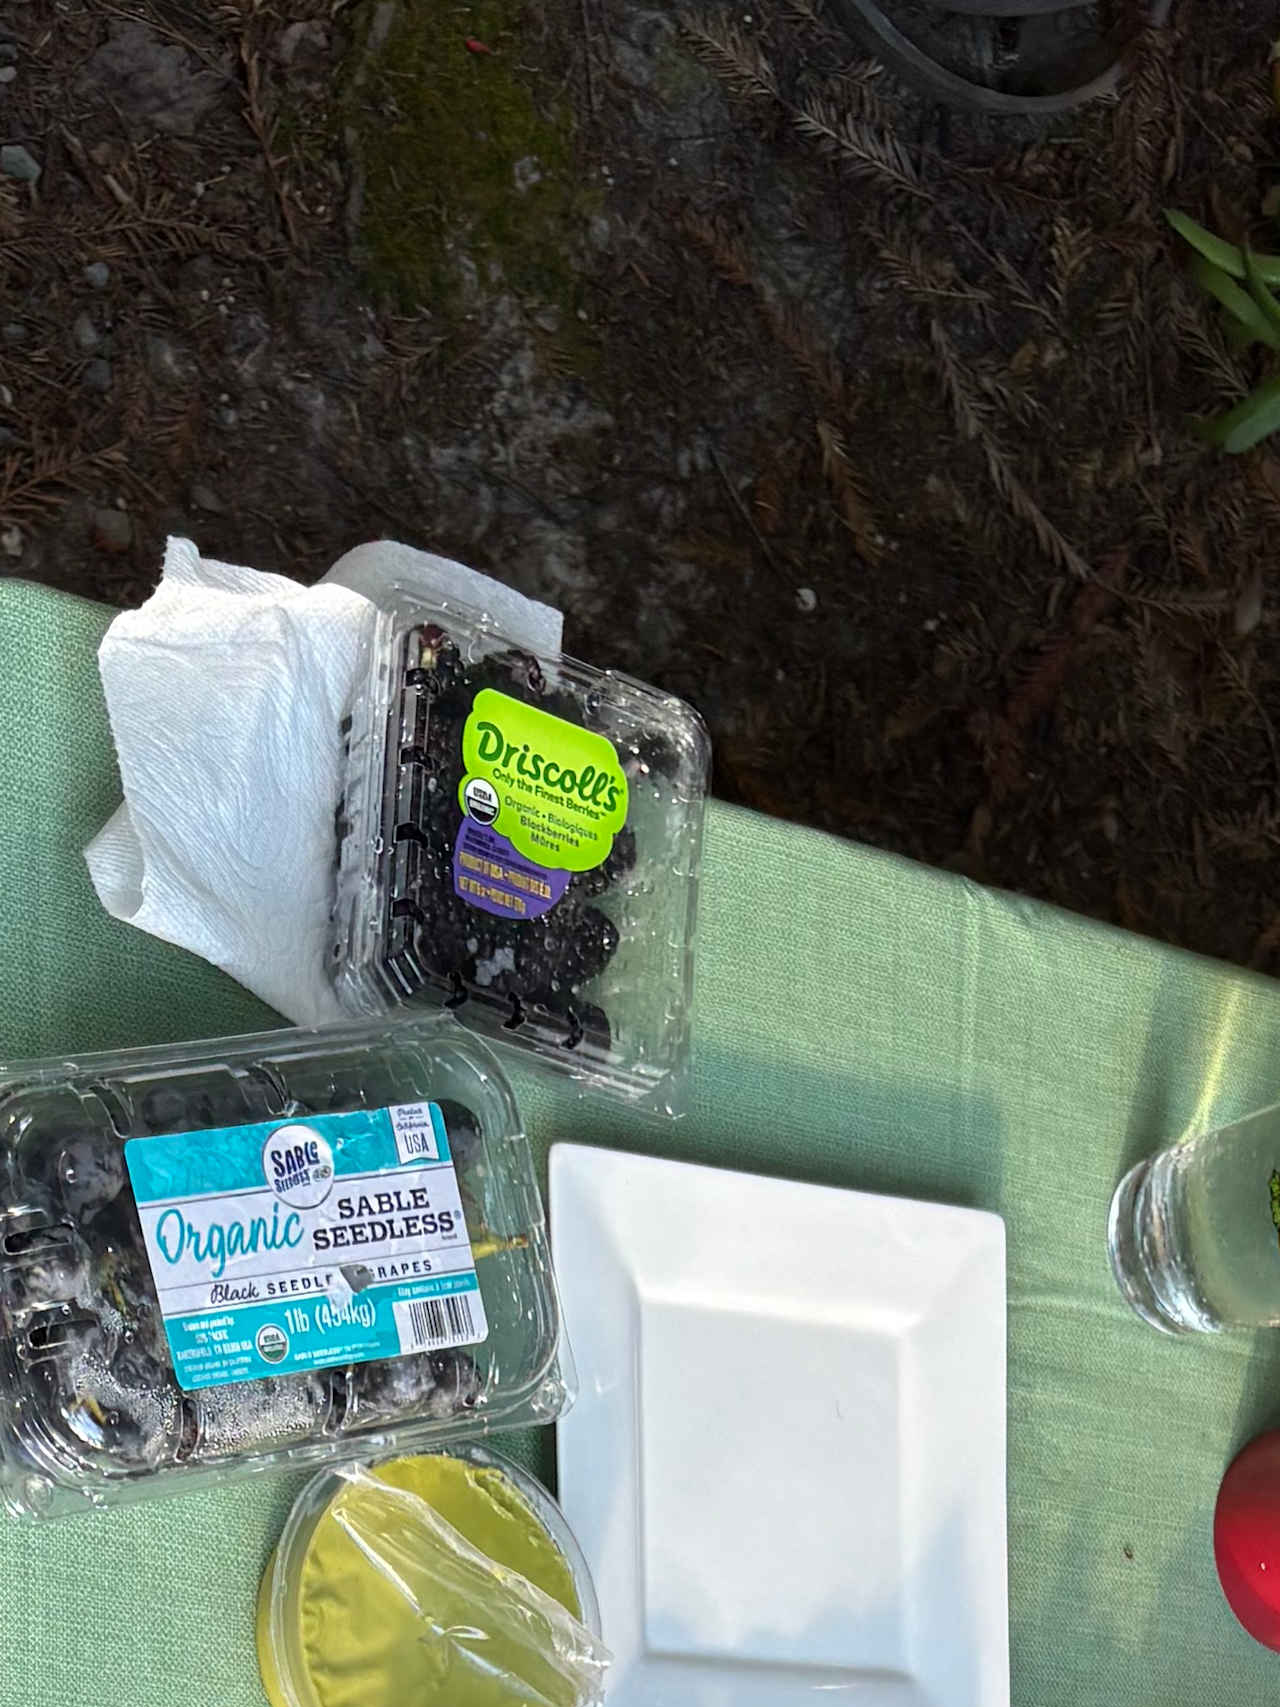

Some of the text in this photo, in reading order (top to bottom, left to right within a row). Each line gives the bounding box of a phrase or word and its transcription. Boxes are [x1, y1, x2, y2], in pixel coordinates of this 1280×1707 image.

[477, 721, 619, 811] Driscoll's
[492, 768, 516, 788] Only
[517, 778, 533, 793] the
[534, 785, 563, 806] Finest
[505, 795, 540, 818] Organic
[520, 816, 580, 848] Blackberries
[404, 1132, 429, 1155] USA
[337, 1187, 430, 1220] SABLE
[156, 1201, 305, 1279] Organic
[312, 1210, 455, 1251] SEEDLESS
[210, 1281, 260, 1305] Black
